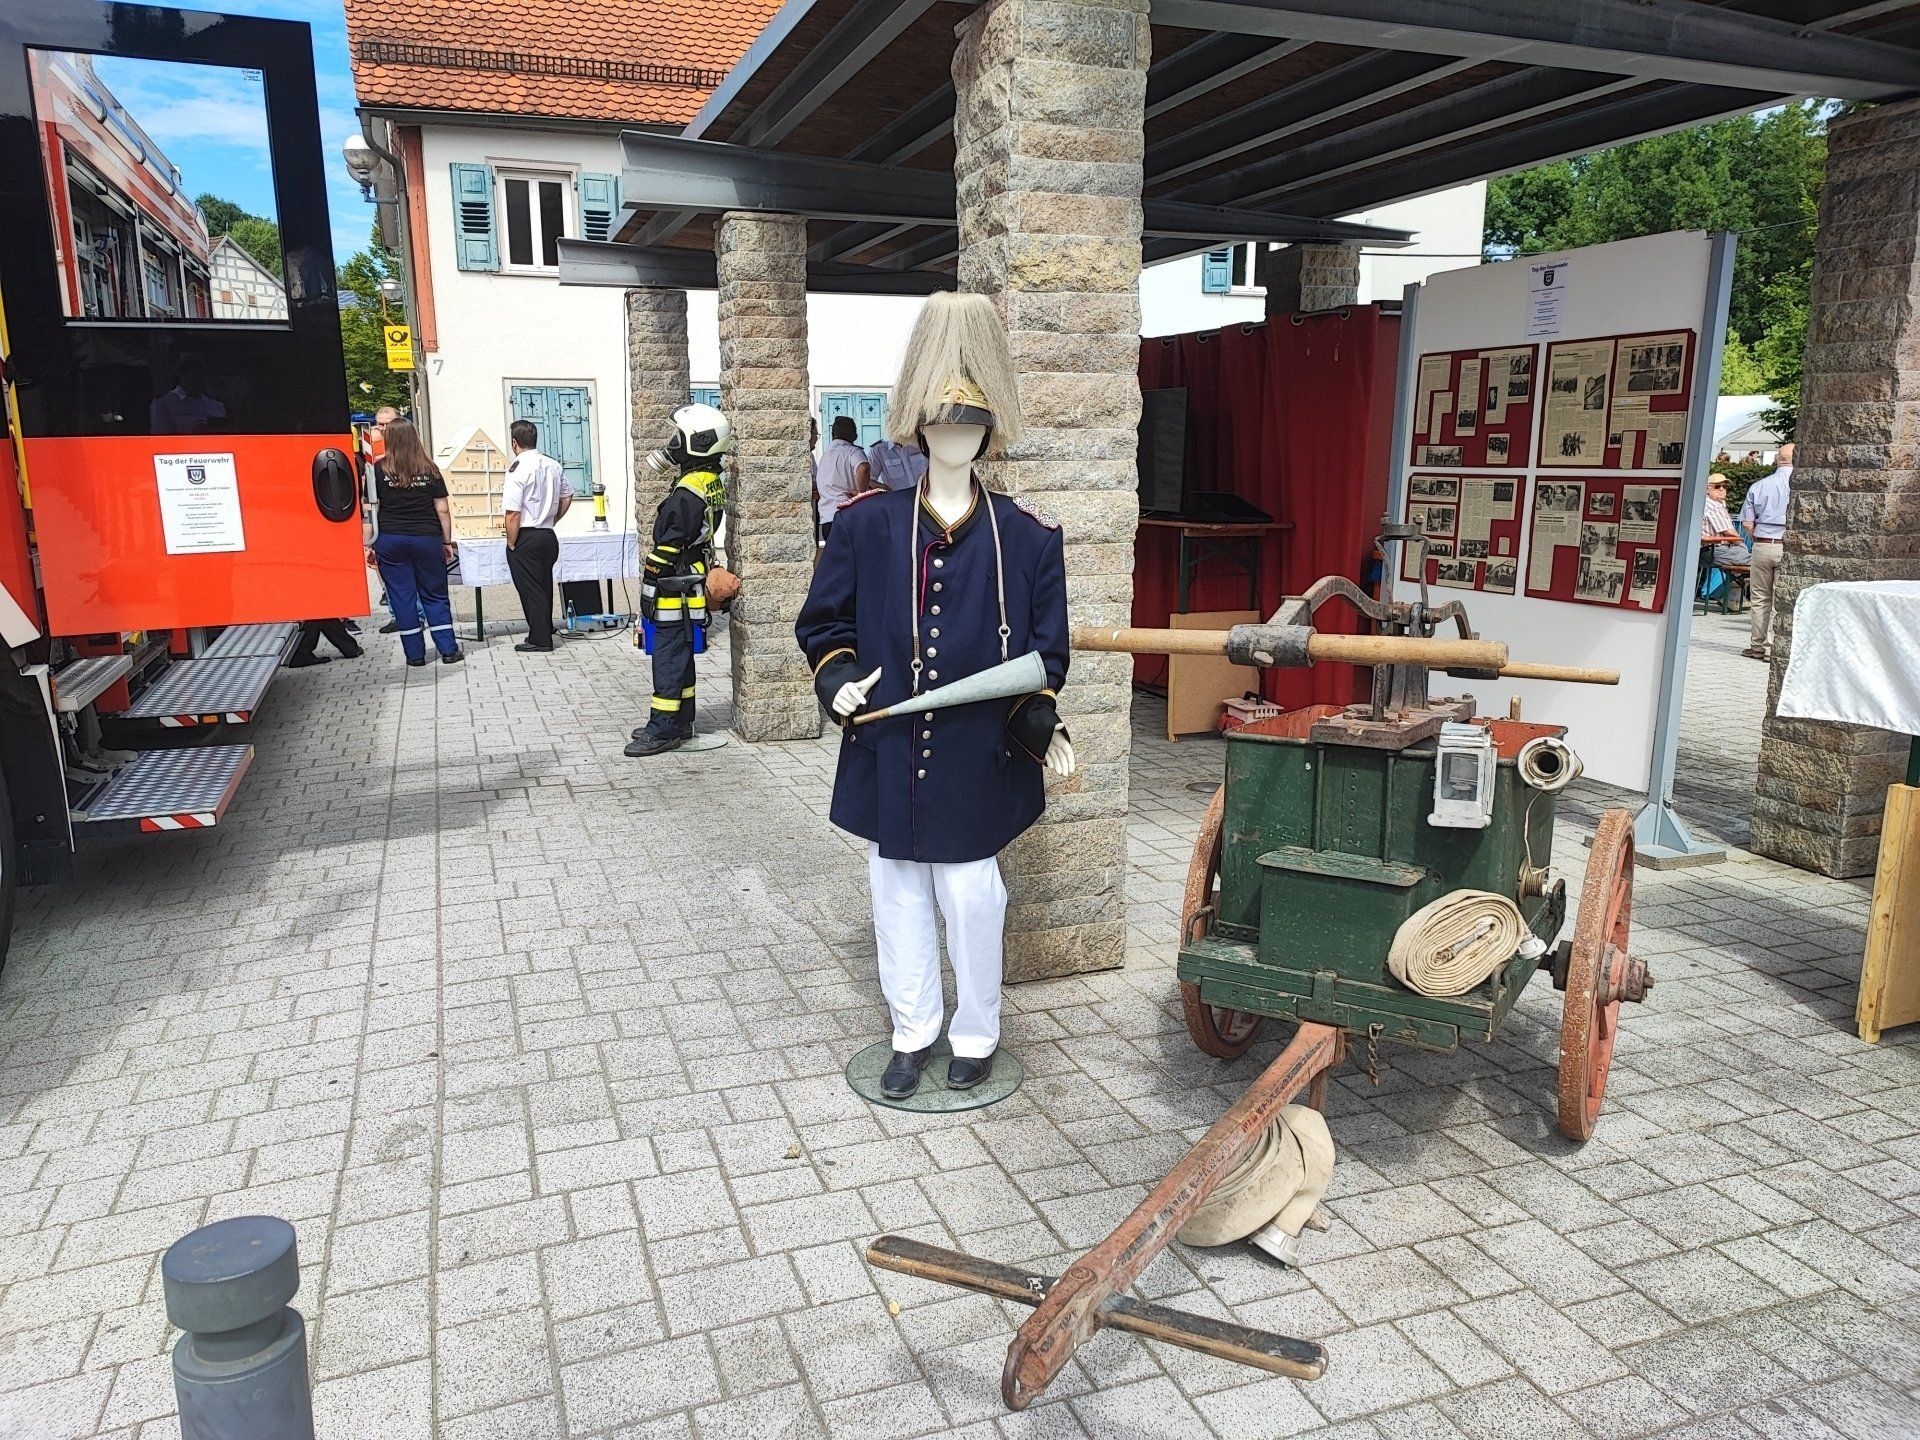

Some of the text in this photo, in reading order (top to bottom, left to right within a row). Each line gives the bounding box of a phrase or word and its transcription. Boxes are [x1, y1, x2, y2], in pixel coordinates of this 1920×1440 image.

[1547, 262, 1568, 270] Feuerwehr
[433, 359, 444, 375] 7
[159, 458, 173, 466] Tag
[189, 456, 229, 464] Feuerwehr
